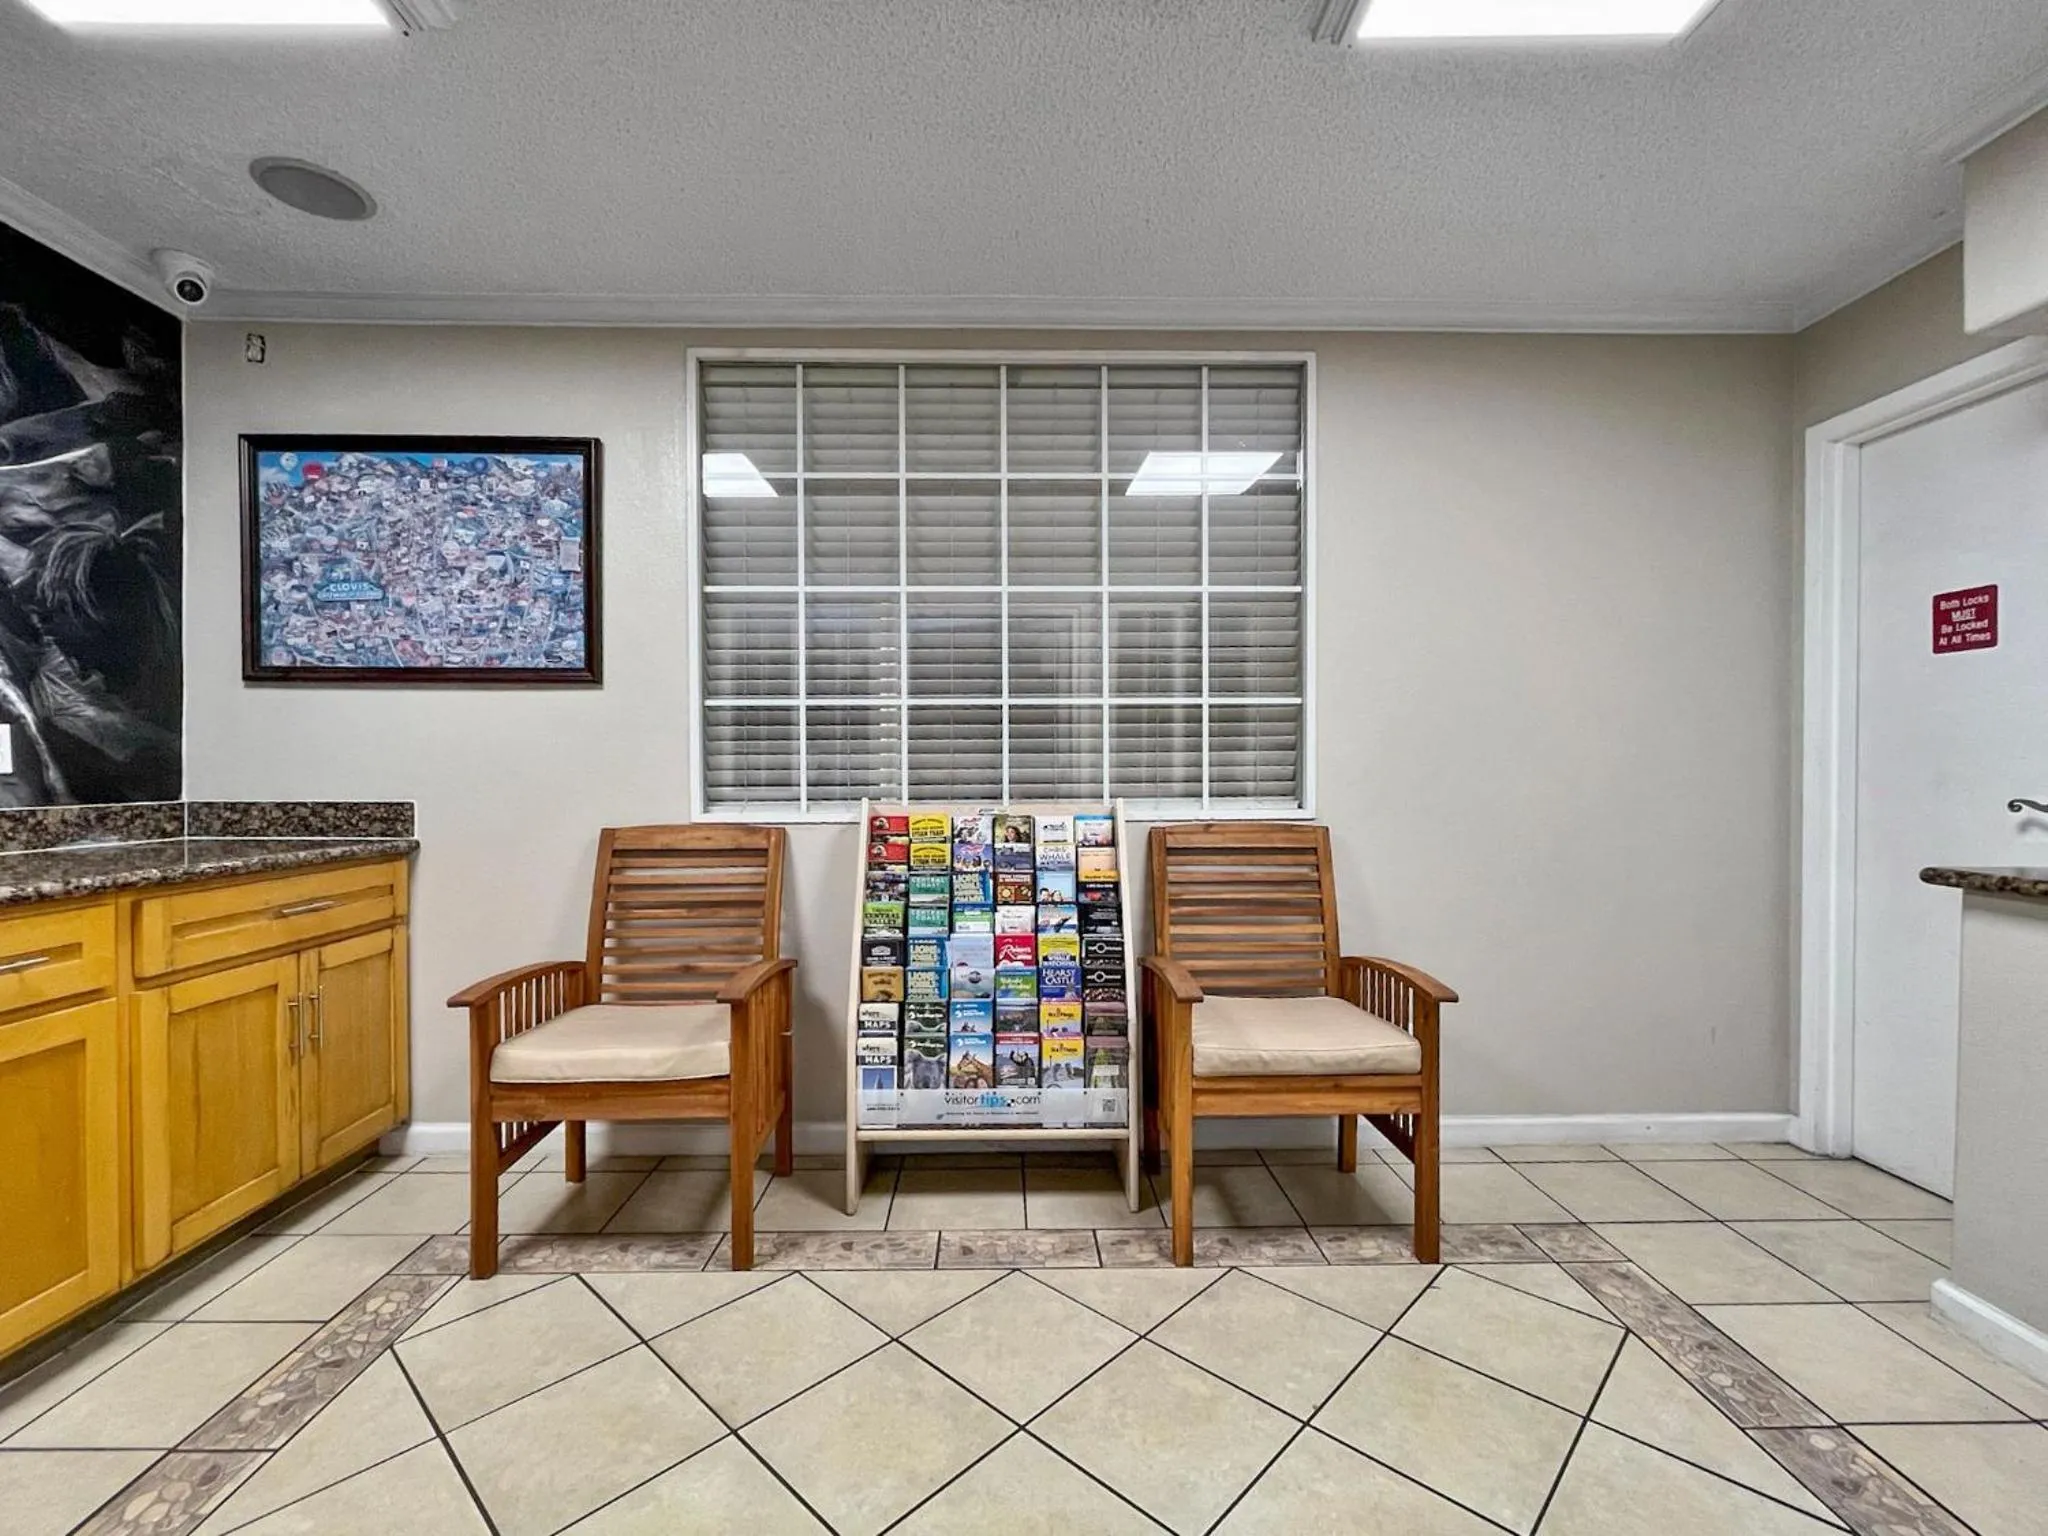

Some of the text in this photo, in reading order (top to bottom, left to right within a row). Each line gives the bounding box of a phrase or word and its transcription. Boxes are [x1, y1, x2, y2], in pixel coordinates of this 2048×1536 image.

[329, 583, 369, 591] CLOVIS
[1940, 595, 1989, 610] Both Locks
[1951, 608, 1976, 620] MUST
[1941, 619, 1989, 634] Be Locked
[1939, 632, 1991, 646] At All Times
[1042, 969, 1076, 977] HEARST
[1045, 977, 1075, 985] CASTLE
[944, 1092, 1041, 1107] visitortips.com
